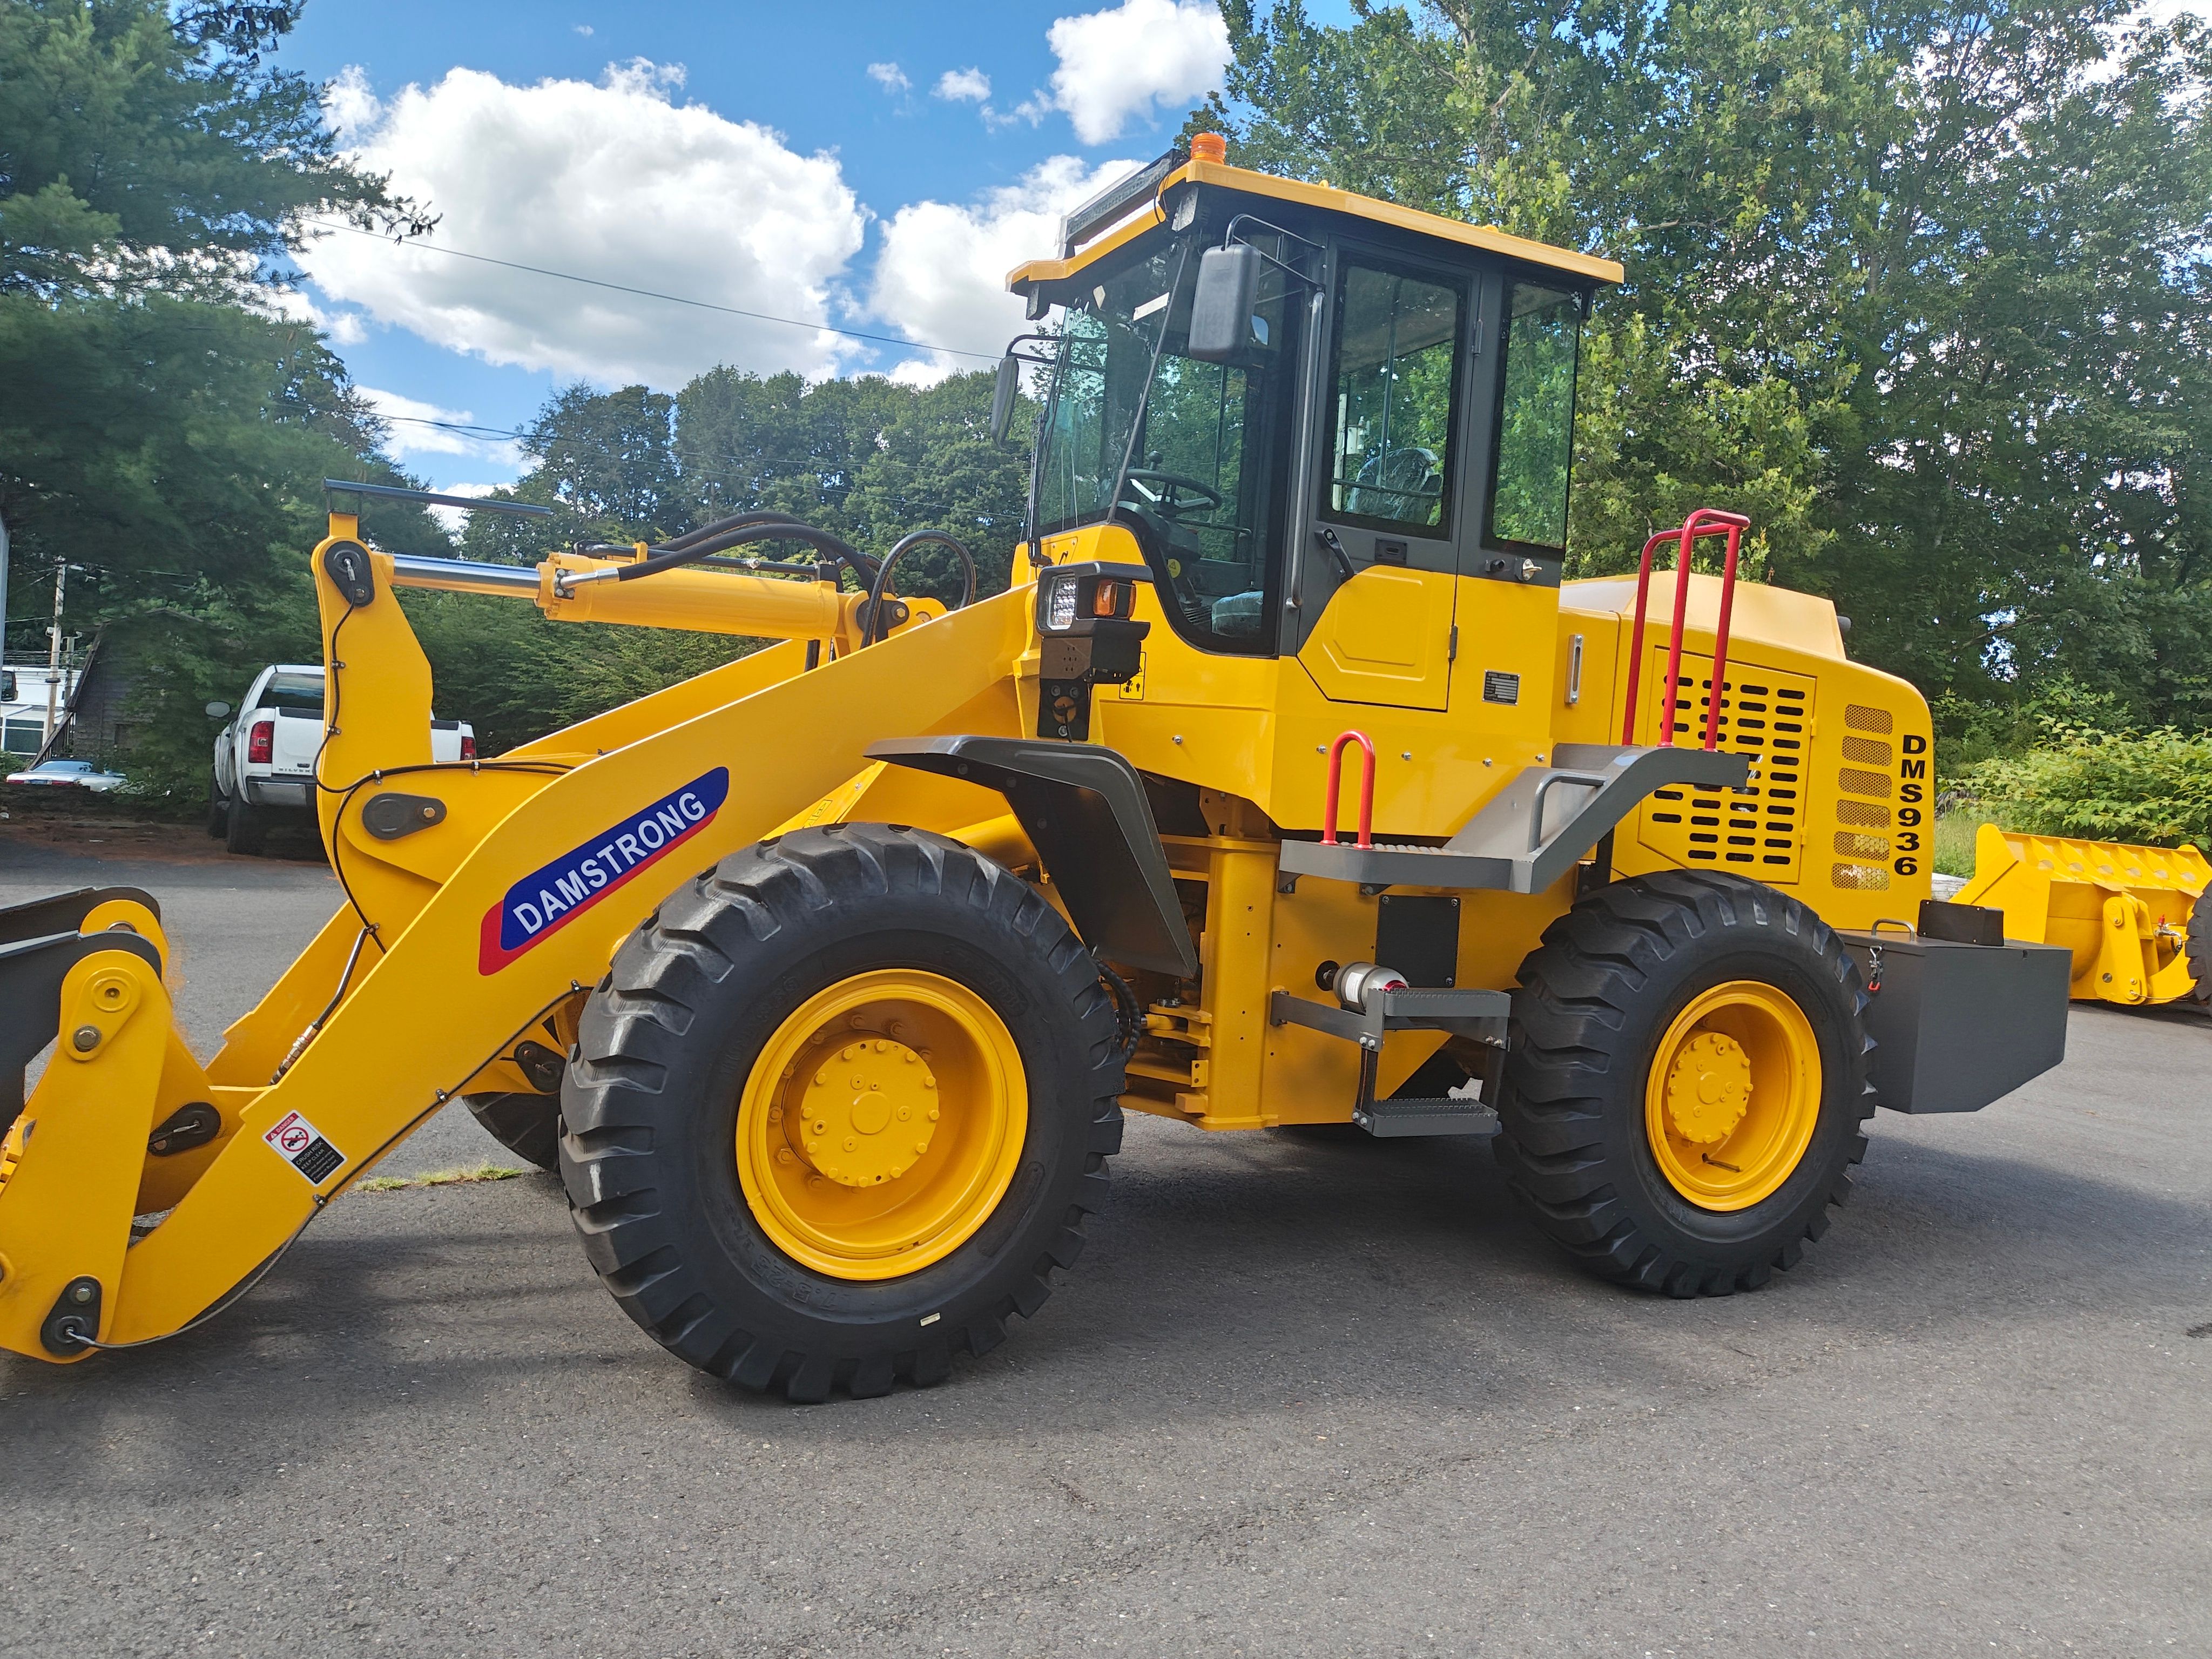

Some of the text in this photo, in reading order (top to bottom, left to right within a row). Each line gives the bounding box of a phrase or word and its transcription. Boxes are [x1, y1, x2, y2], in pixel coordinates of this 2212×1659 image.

[1894, 734, 1926, 875] DMS936
[512, 792, 706, 934] DAMSTRONG
[275, 1116, 295, 1132] DANGER
[296, 1150, 313, 1165] CRUSH
[311, 1141, 323, 1152] RISK
[301, 1160, 312, 1170] KEEP
[311, 1149, 325, 1161] CLEAR
